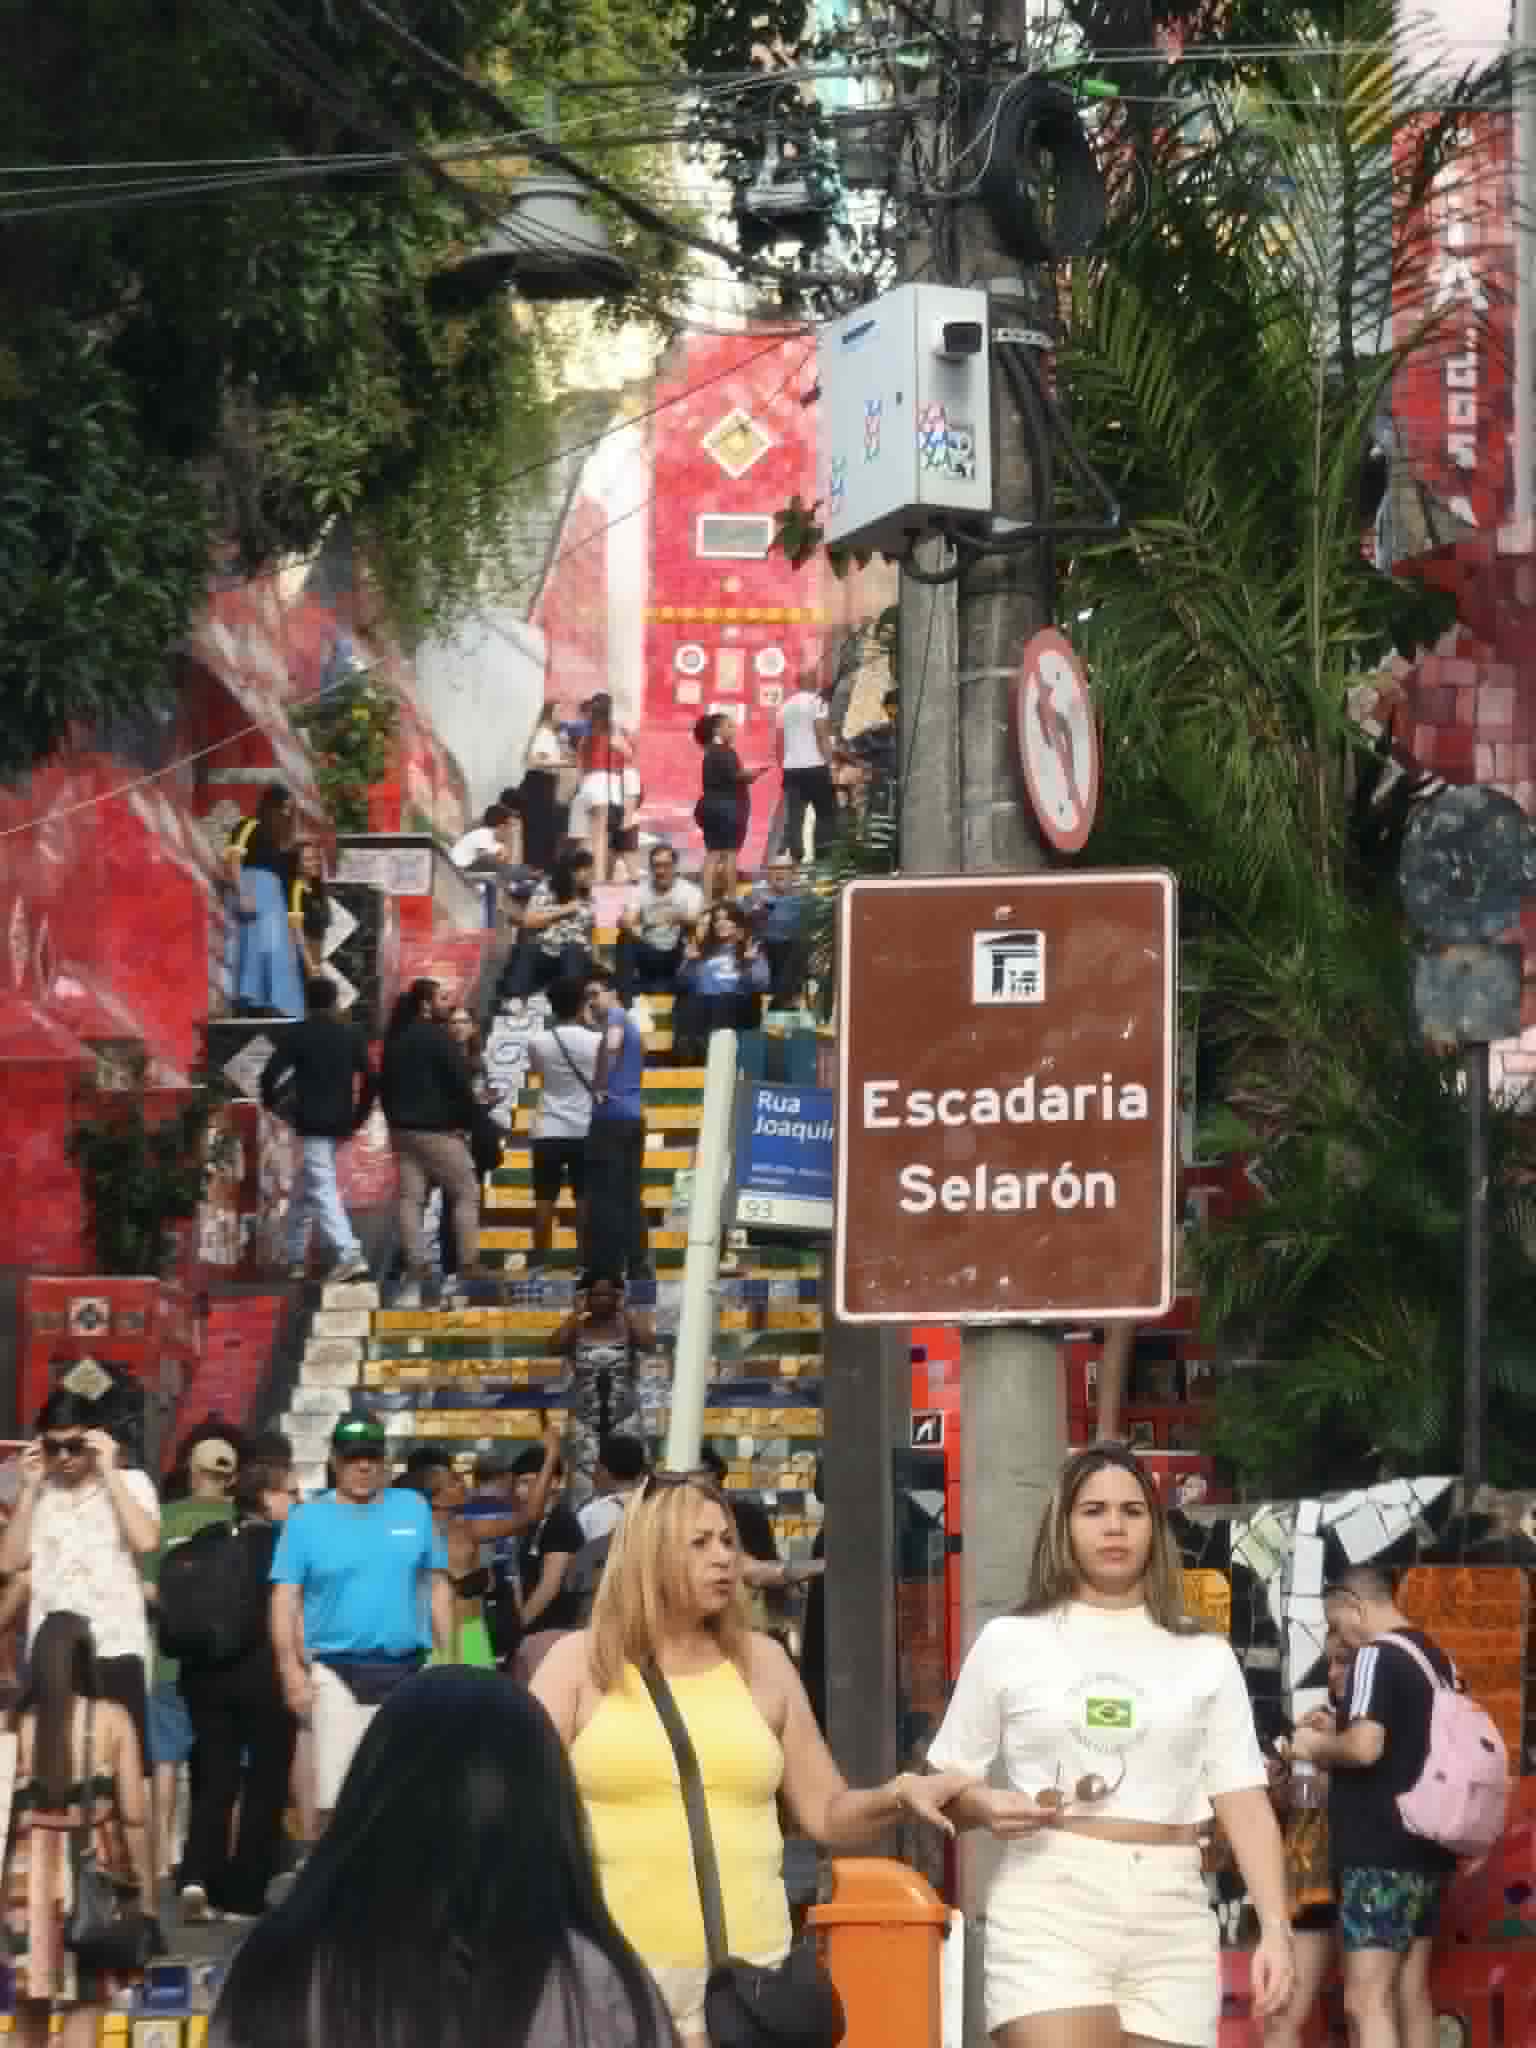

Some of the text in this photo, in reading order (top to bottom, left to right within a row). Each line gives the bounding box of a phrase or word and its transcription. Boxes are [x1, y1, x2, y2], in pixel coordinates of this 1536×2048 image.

[757, 1090, 800, 1114] Rua
[863, 1073, 1148, 1128] Escadaria
[899, 1162, 1117, 1212] Selarón
